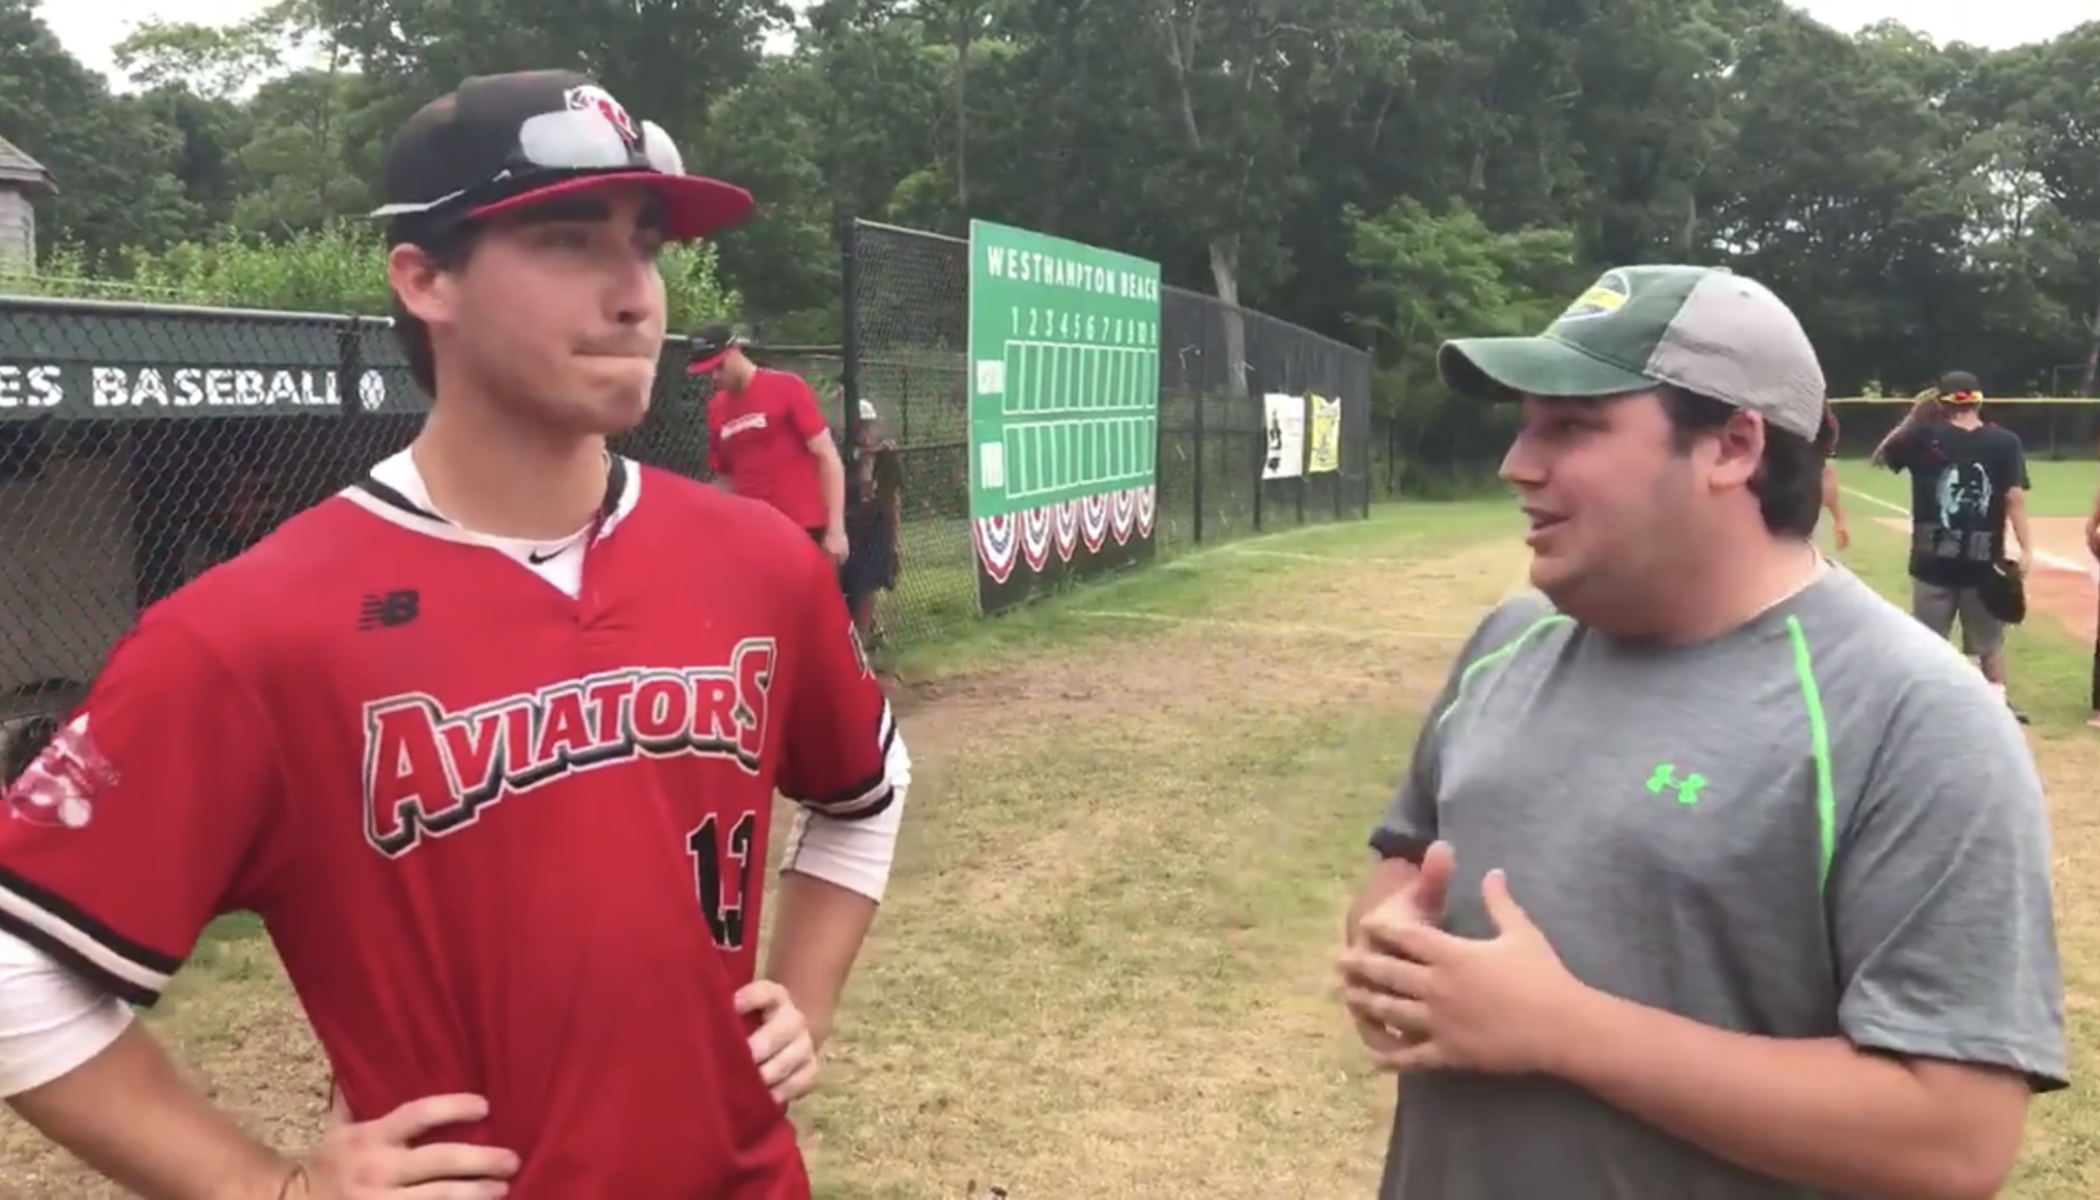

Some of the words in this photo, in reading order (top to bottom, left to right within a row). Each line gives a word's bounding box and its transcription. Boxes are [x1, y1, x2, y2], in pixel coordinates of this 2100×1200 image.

[987, 245, 1116, 295] WESTHAMPTON
[1011, 305, 1019, 336] 1
[1028, 307, 1038, 337] 2
[1045, 309, 1054, 338] 3
[1060, 311, 1069, 339] 4
[1073, 313, 1081, 340] 5
[1086, 314, 1096, 341] 6
[1101, 316, 1110, 342] 7
[92, 367, 342, 407] BASEBALL
[362, 636, 777, 860] AVIATORS
[685, 810, 756, 952] 13
